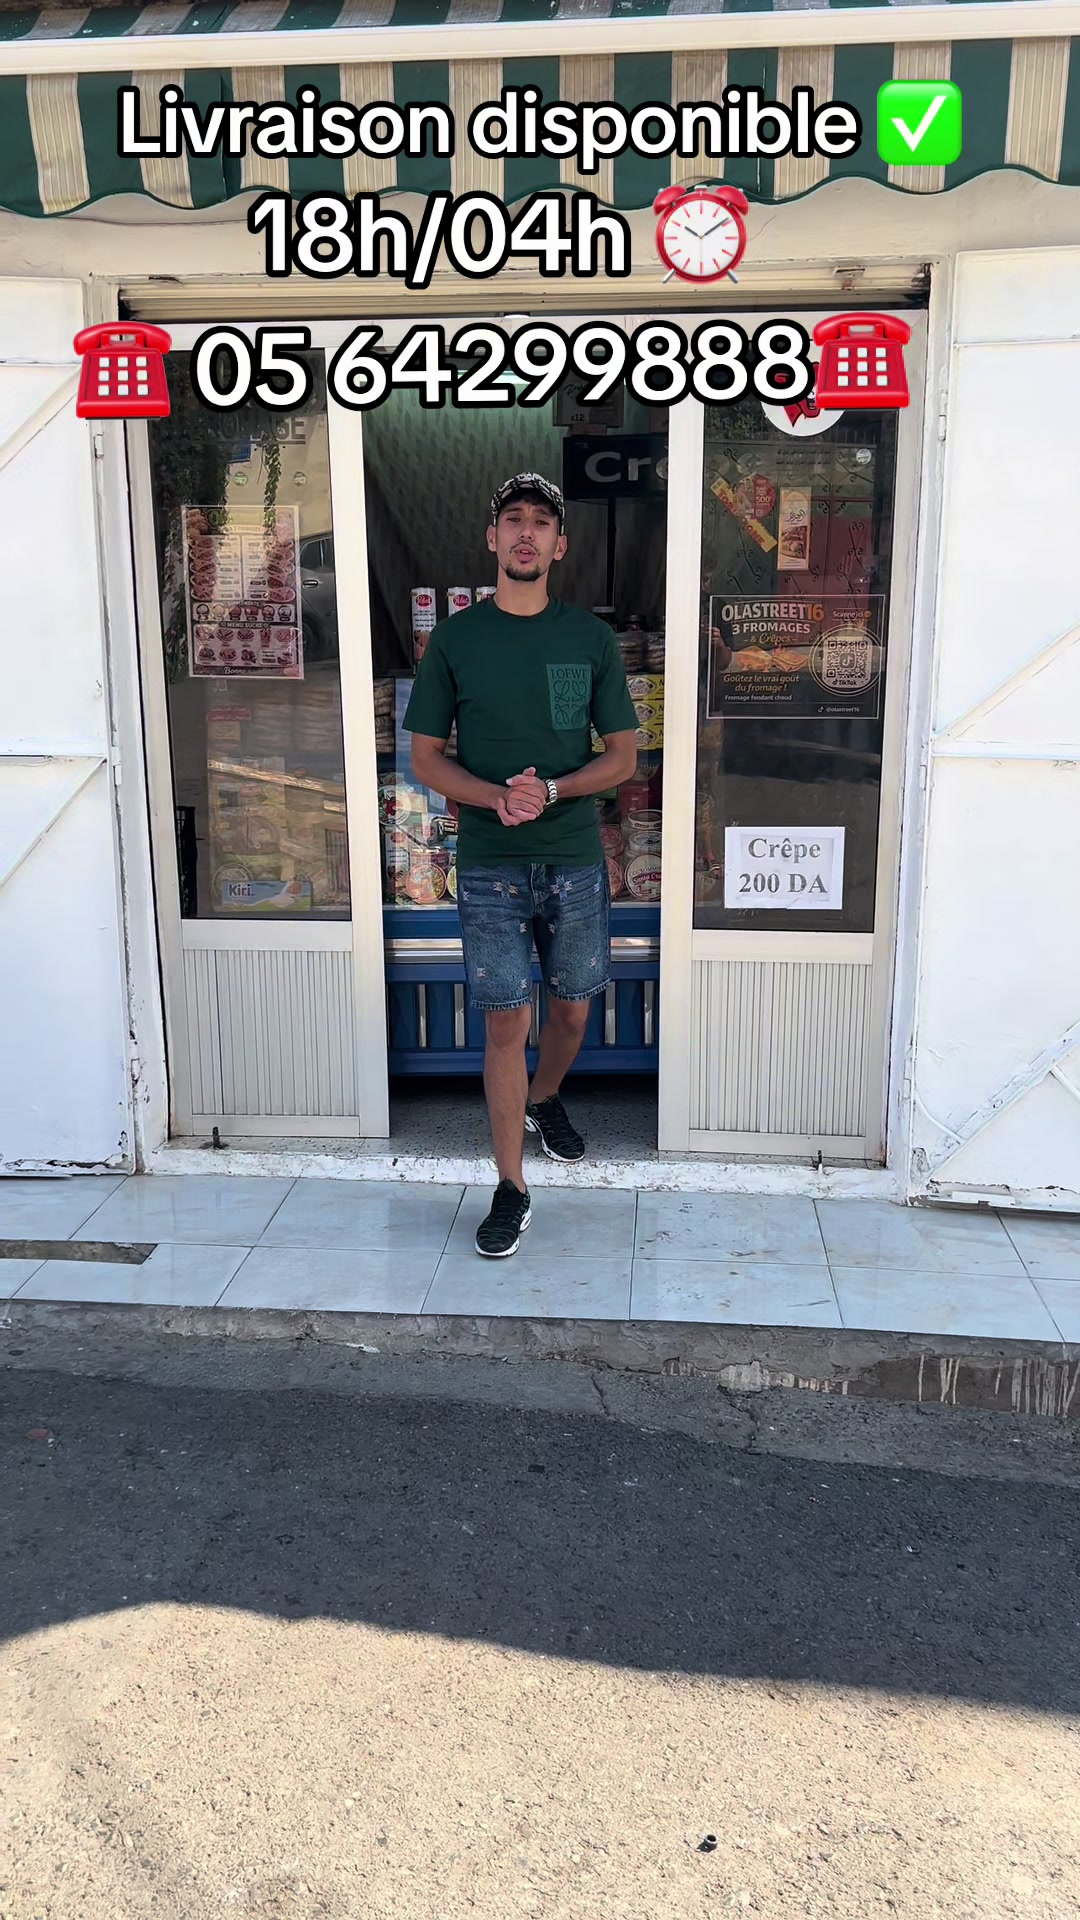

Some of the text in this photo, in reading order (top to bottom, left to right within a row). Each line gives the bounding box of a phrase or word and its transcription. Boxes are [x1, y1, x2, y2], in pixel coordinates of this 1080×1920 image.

[721, 603, 825, 622] OLASTREET16
[732, 622, 811, 635] 3 FROMAGES
[723, 674, 753, 683] Goûtez
[754, 674, 762, 683] le
[763, 675, 779, 683] vrai
[735, 684, 746, 692] du
[747, 838, 821, 863] Crêpe
[739, 873, 827, 893] 200 DA
[228, 884, 251, 897] Kiri
